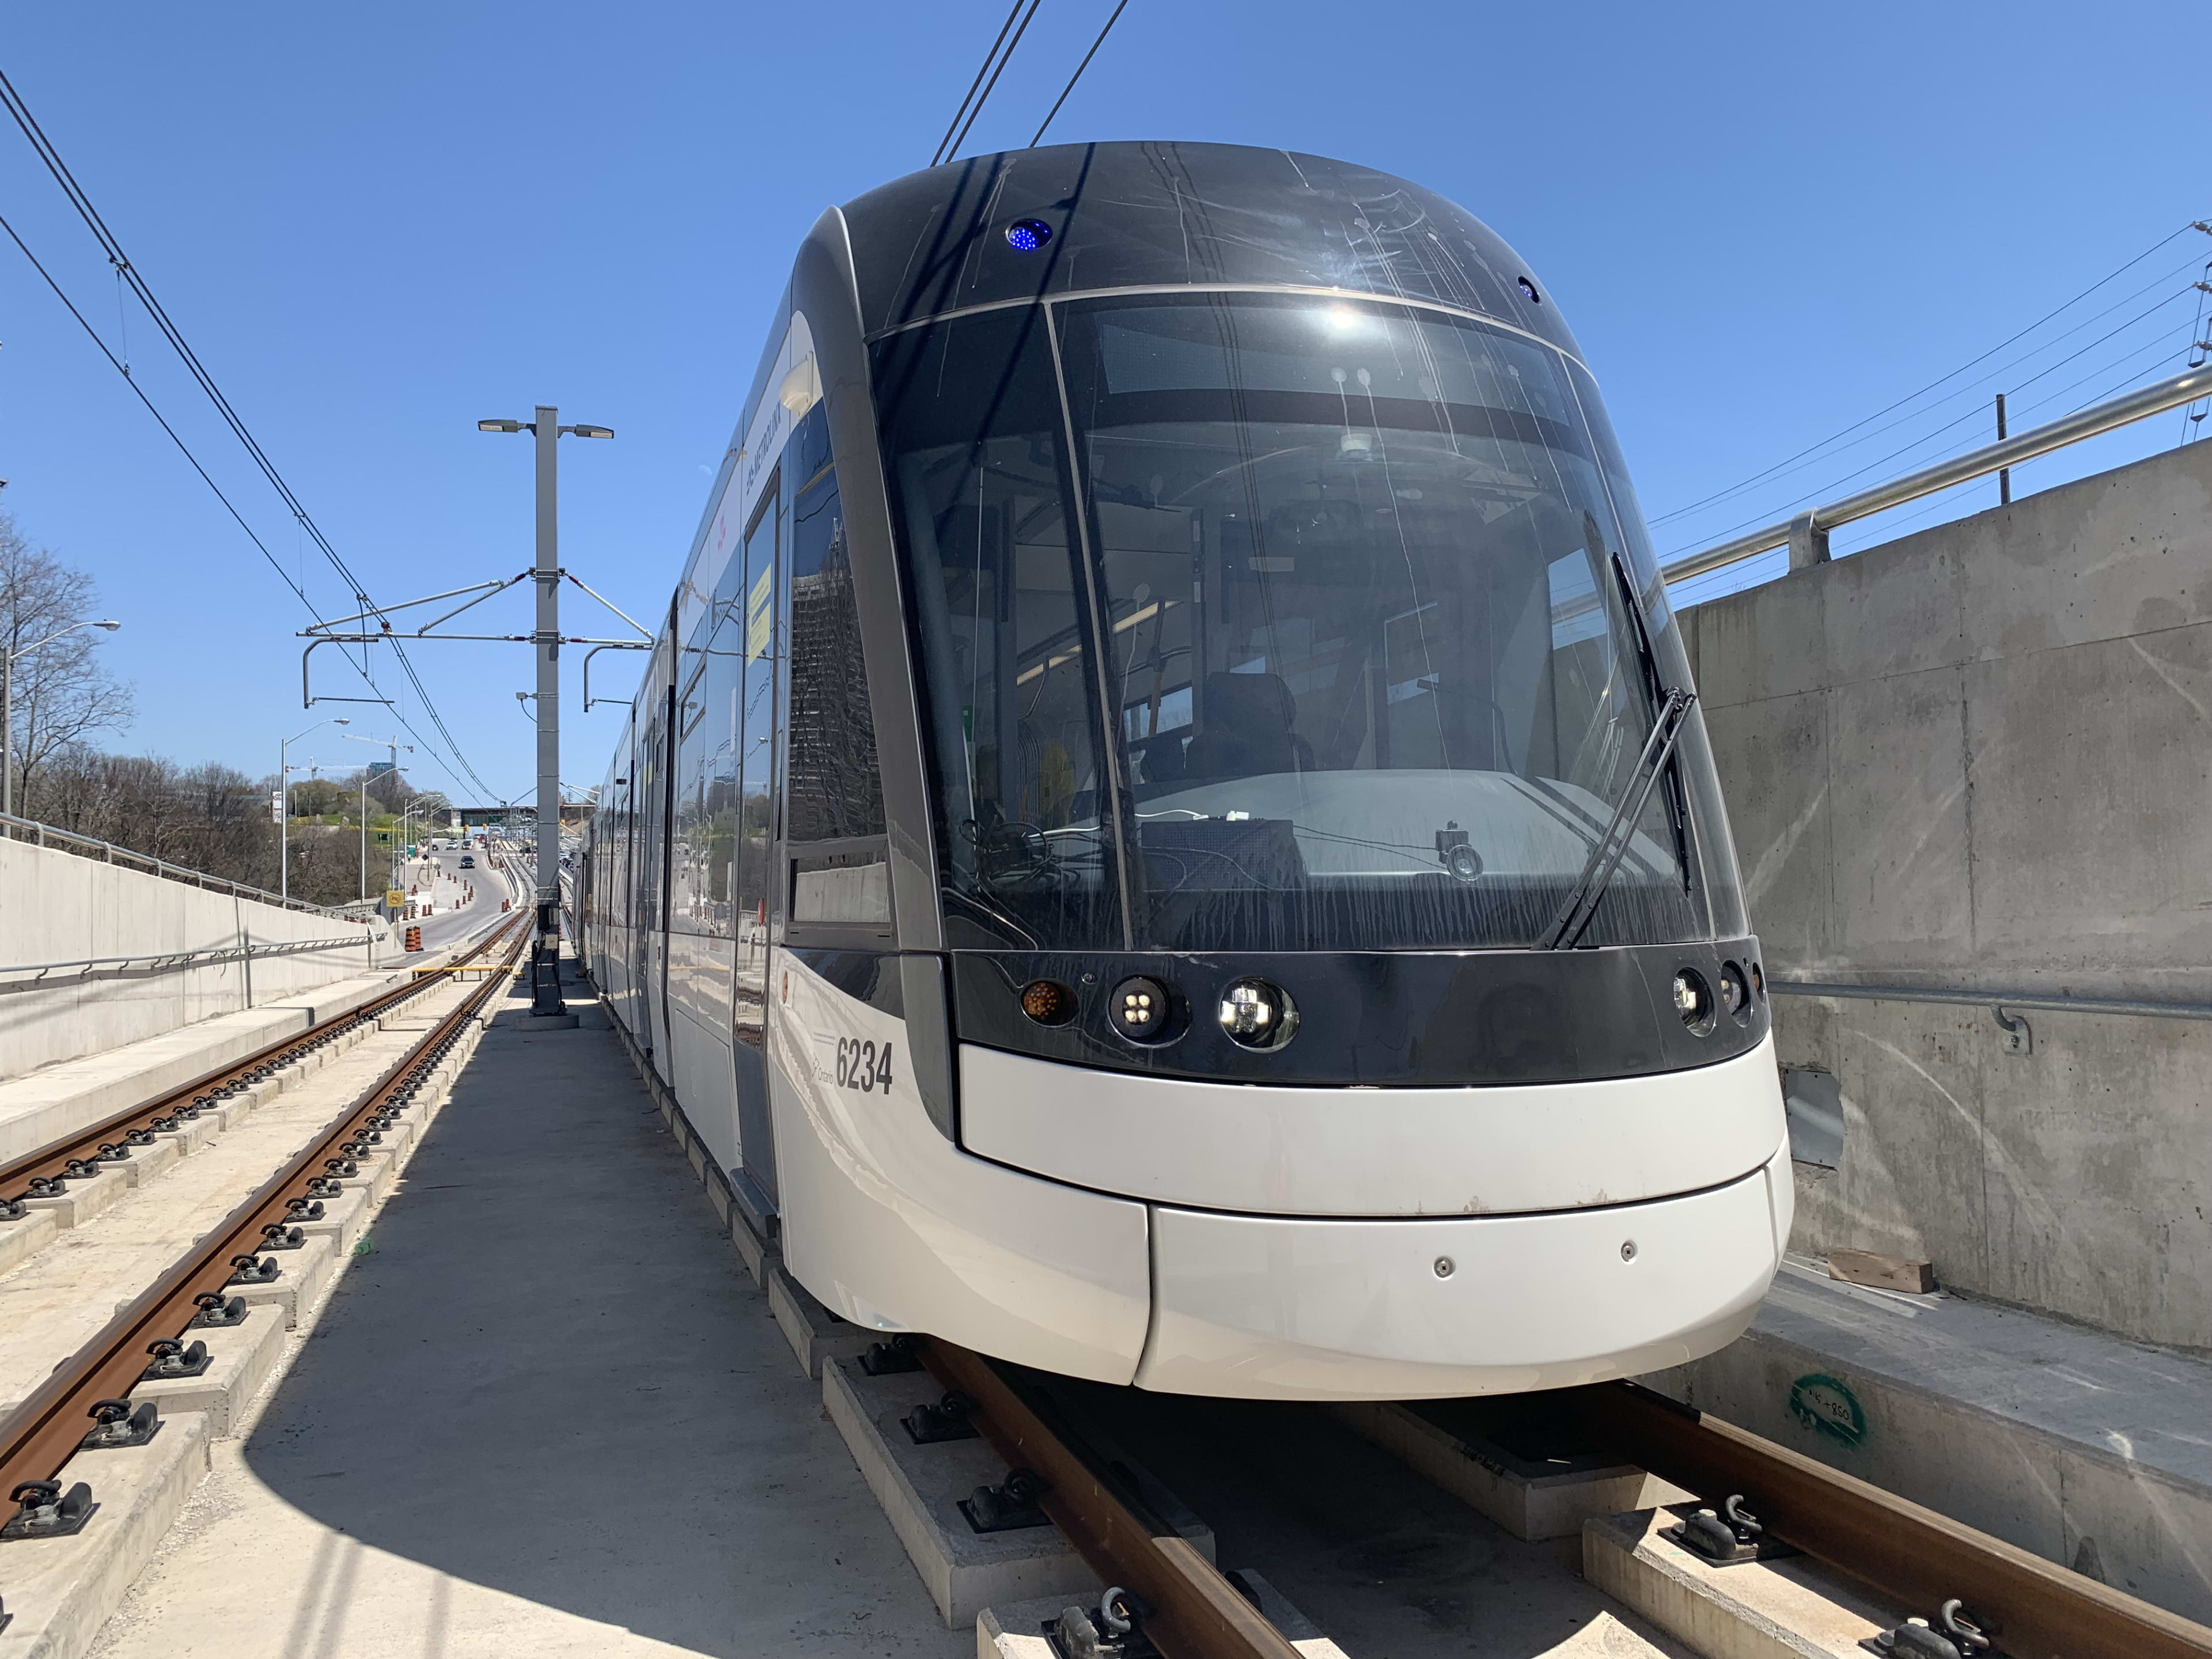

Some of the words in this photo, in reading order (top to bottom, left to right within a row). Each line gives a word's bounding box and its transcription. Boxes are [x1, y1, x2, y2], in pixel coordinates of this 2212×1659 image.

[755, 399, 781, 475] METROLINX
[818, 1069, 834, 1084] Ontario
[836, 1036, 892, 1094] 6234
